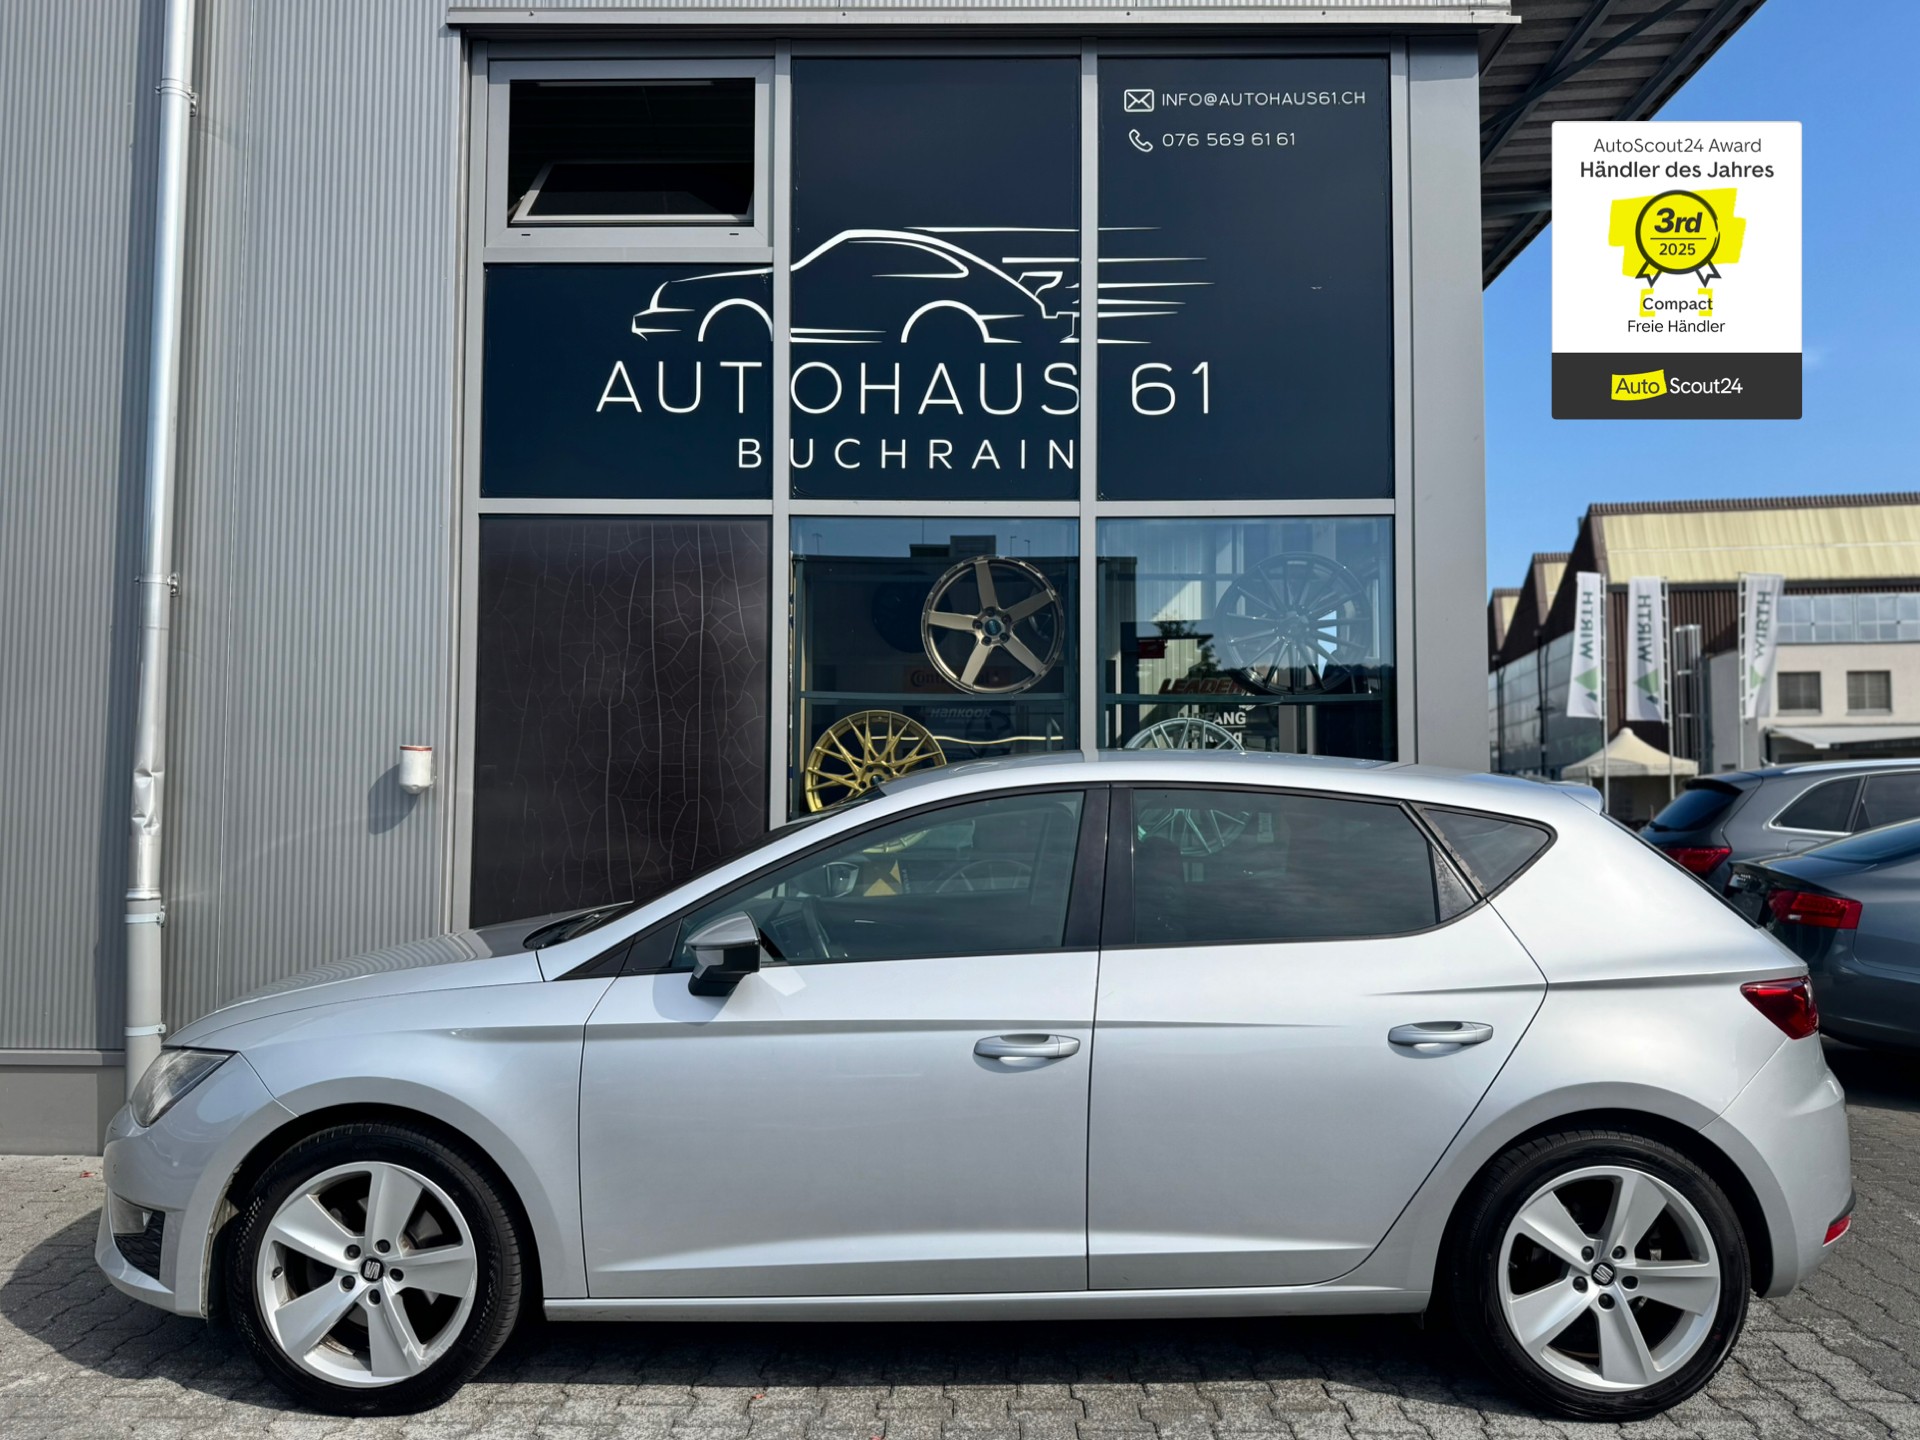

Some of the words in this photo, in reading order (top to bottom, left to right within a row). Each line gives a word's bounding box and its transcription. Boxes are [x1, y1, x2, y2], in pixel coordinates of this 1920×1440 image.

[1161, 91, 1366, 107] INFO@AUTOHAUS61.CH
[1162, 133, 1200, 147] 076
[1206, 132, 1245, 147] 569
[1251, 132, 1270, 146] 61
[1276, 132, 1296, 146] 61
[596, 361, 1080, 415] AUTOHAUS
[1130, 361, 1210, 415] 61
[737, 438, 1074, 470] BUCHRAIN
[1755, 591, 1771, 659] WIRTH
